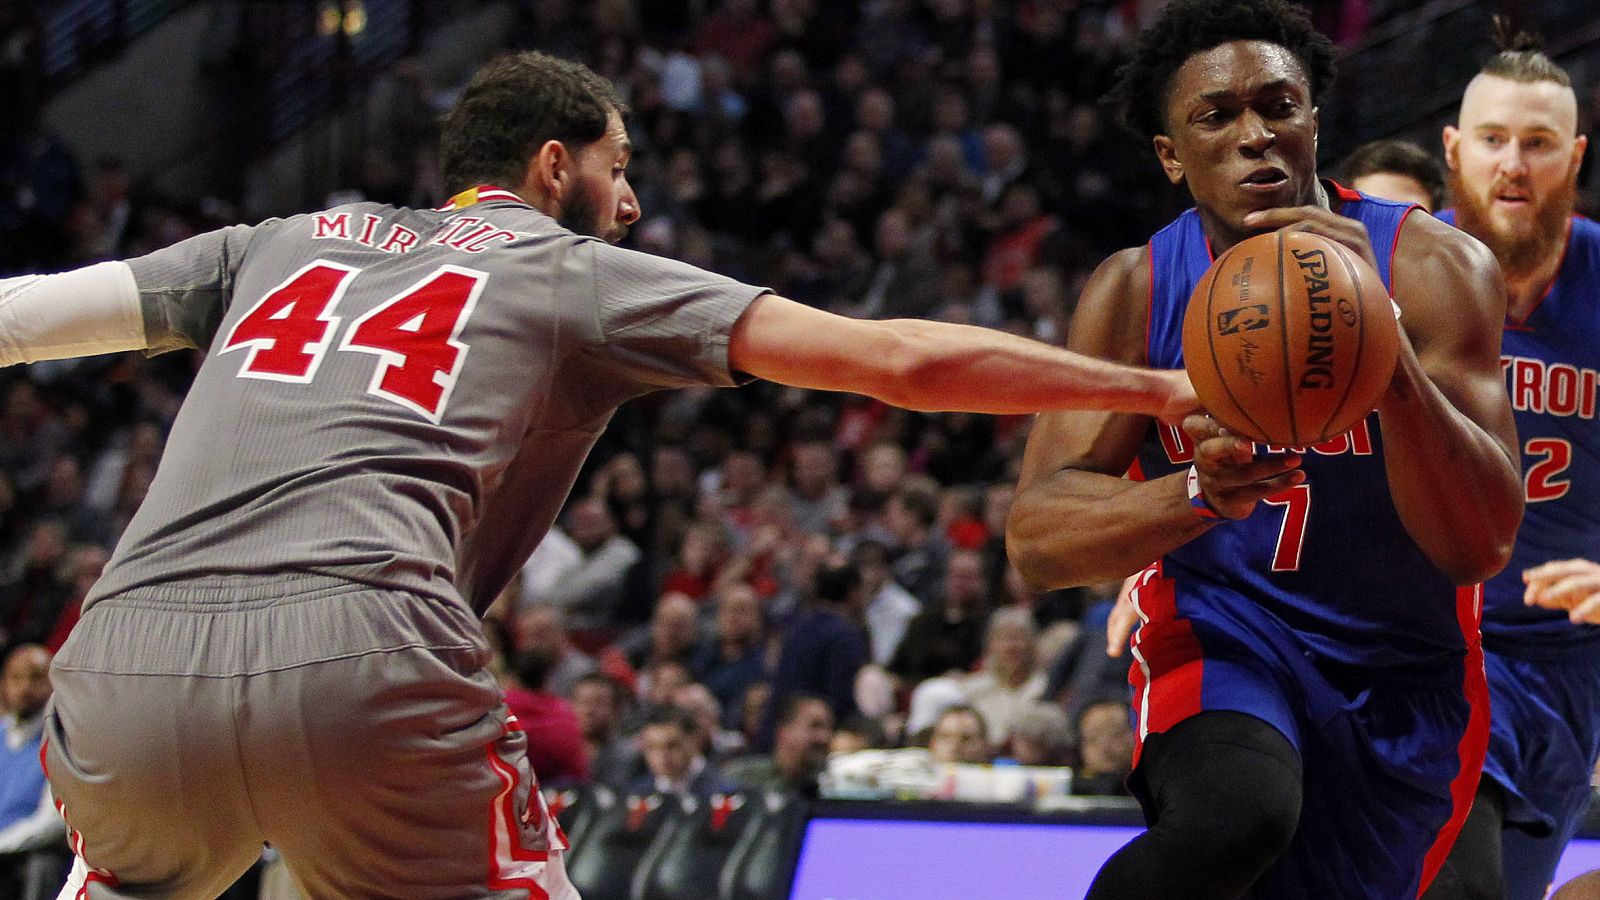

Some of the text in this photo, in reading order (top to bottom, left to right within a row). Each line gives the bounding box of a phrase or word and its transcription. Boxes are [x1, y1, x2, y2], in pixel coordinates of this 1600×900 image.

[311, 211, 520, 254] MIRTIC
[217, 258, 490, 425] 44
[1291, 248, 1336, 390] SPALDING
[1500, 355, 1600, 420] ROI
[1262, 483, 1312, 572] 7
